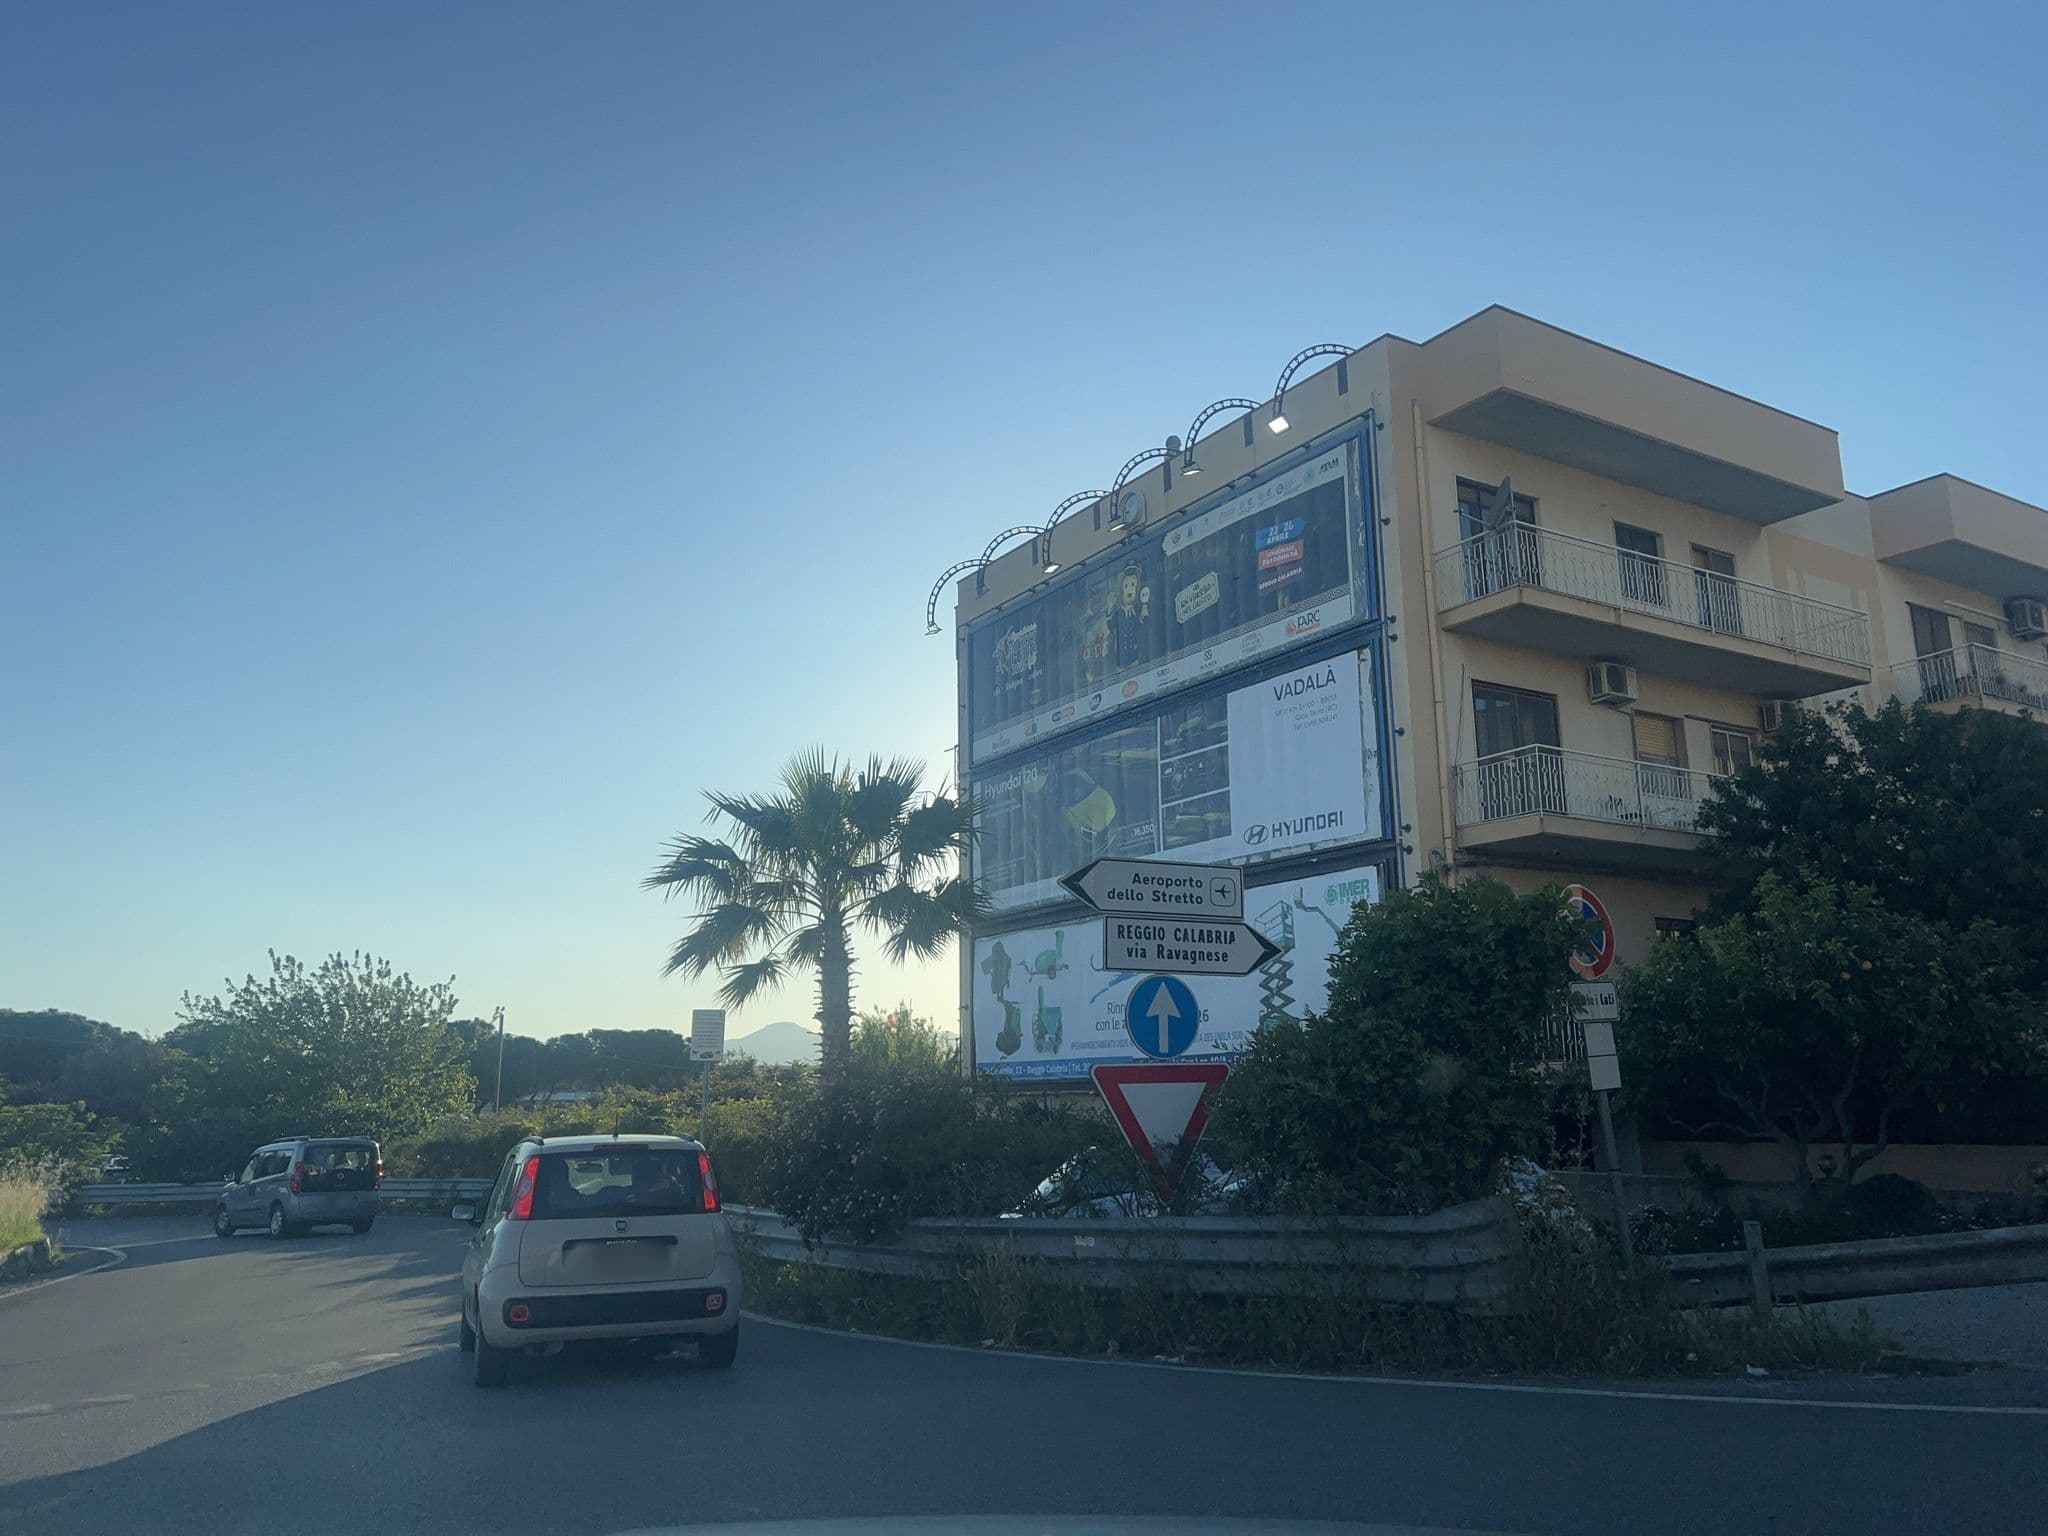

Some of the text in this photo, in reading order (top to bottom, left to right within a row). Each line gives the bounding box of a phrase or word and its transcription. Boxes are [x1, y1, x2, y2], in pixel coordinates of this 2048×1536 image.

[1267, 531, 1289, 545] APRILE
[1273, 664, 1336, 701] VADALÀ
[984, 772, 1022, 798] Hyundai
[1272, 810, 1344, 838] HYUNDAI
[1132, 872, 1203, 888] Aeroporto
[1339, 878, 1370, 898] IMER
[1107, 888, 1203, 905] dello Stretto
[1117, 924, 1236, 945] REGGIO CALABRIA
[1126, 942, 1229, 965] via Ravagnese
[1107, 1001, 1127, 1015] Rinn
[1600, 993, 1615, 1006] lati
[1096, 1020, 1110, 1032] con
[1111, 1018, 1121, 1031] le
